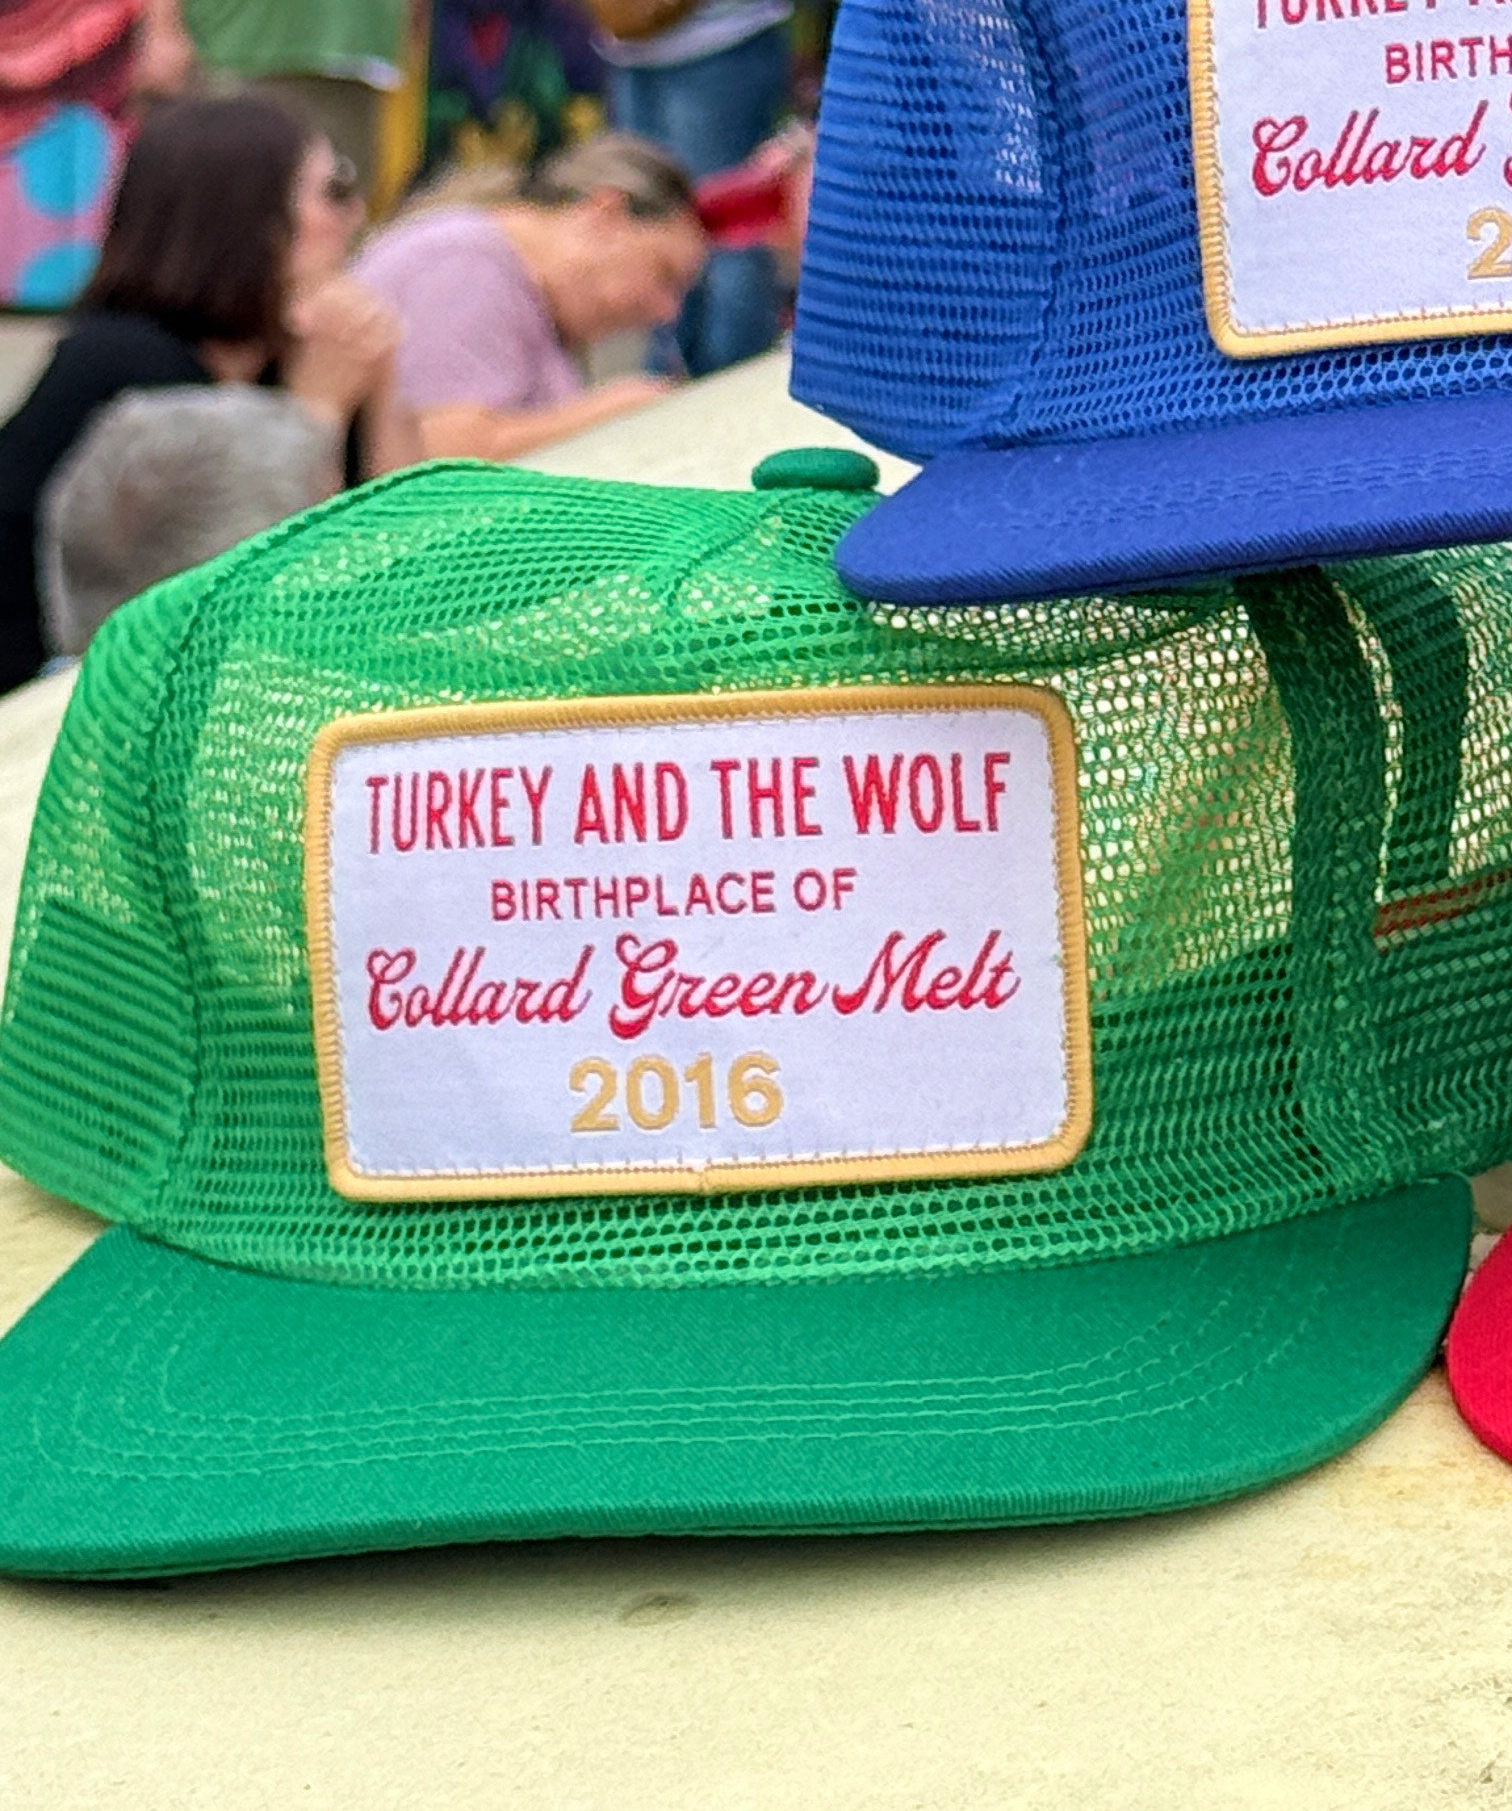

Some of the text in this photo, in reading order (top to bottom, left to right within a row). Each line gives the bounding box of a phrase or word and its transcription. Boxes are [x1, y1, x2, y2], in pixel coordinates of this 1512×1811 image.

[1252, 98, 1487, 198] Collard
[366, 751, 1011, 854] TURKEY AND THE WOLF
[491, 867, 857, 922] BIRTHPLACE OF
[366, 929, 1021, 1040] Collard Green Melt
[569, 1051, 784, 1133] 2016
